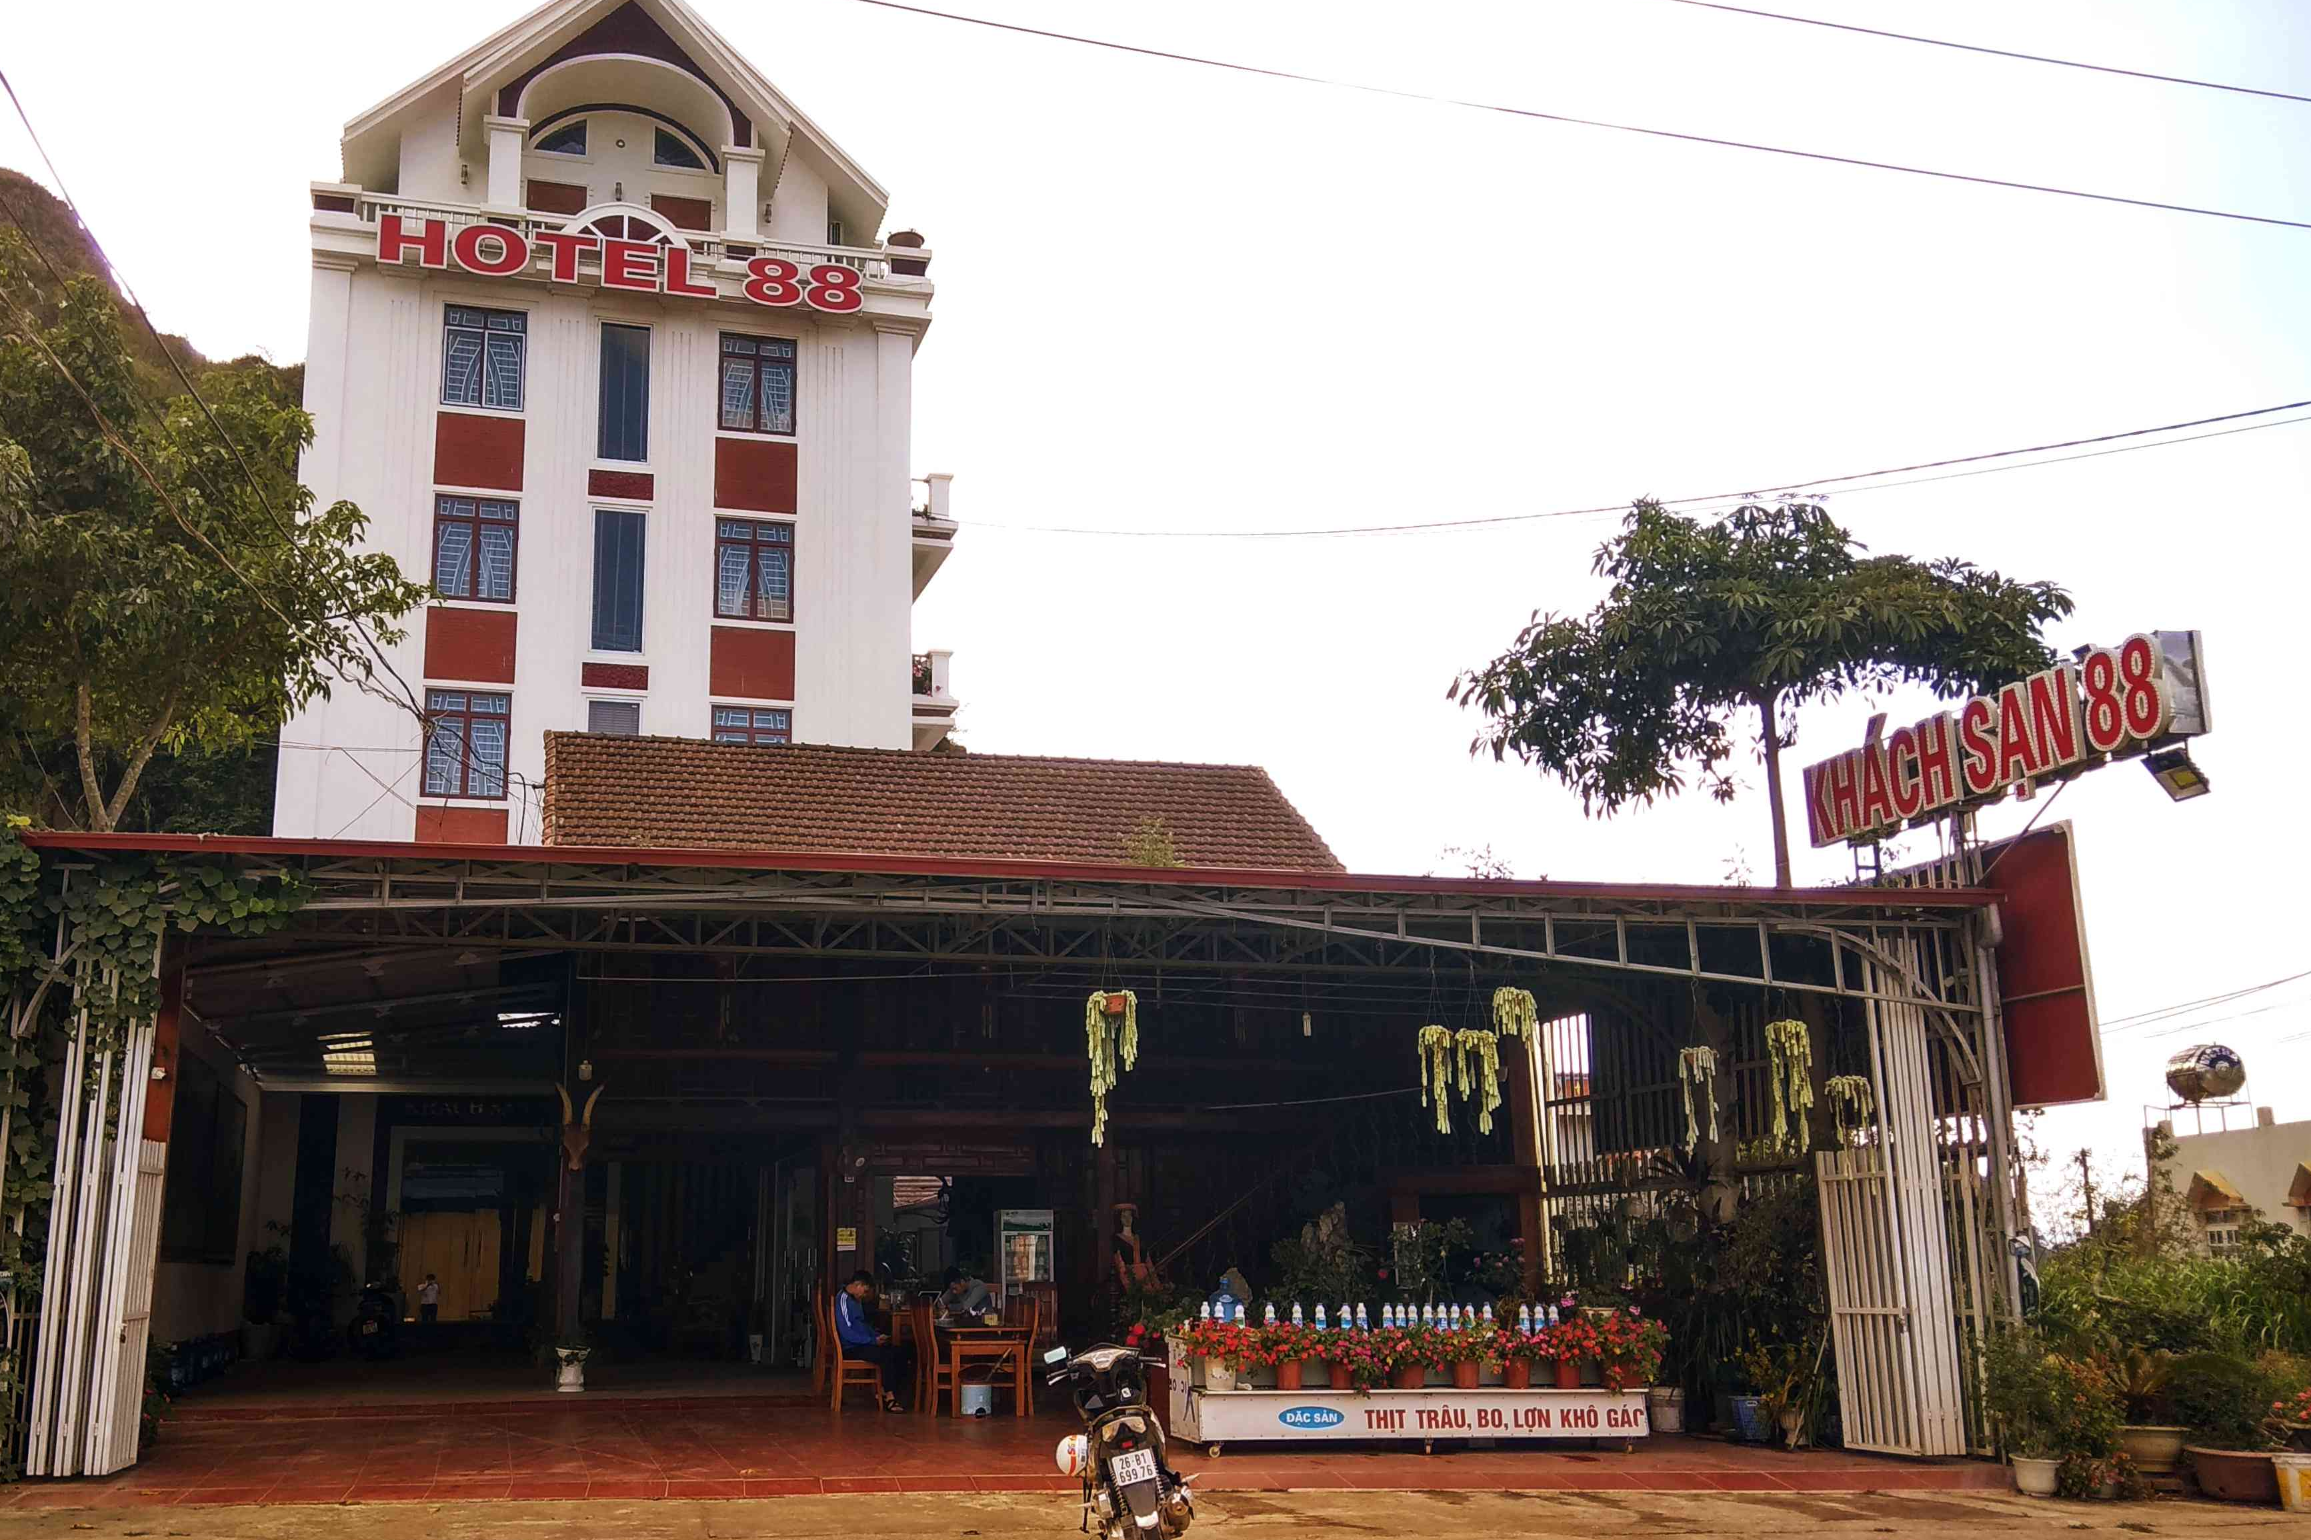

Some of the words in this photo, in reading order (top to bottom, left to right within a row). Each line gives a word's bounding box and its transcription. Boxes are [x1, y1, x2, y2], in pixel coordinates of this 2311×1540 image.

[375, 210, 720, 300] HOTEL
[742, 255, 865, 314] 88
[1803, 712, 1963, 848] KHÁCH
[1960, 662, 2085, 801] SẠN
[2081, 632, 2167, 752] 88
[1313, 1409, 1338, 1423] SẢN
[1364, 1408, 1406, 1433] THỊT
[1415, 1404, 1472, 1431] TRÂU,
[1513, 1406, 1551, 1433] LỢN
[1560, 1404, 1599, 1428] KHÔ
